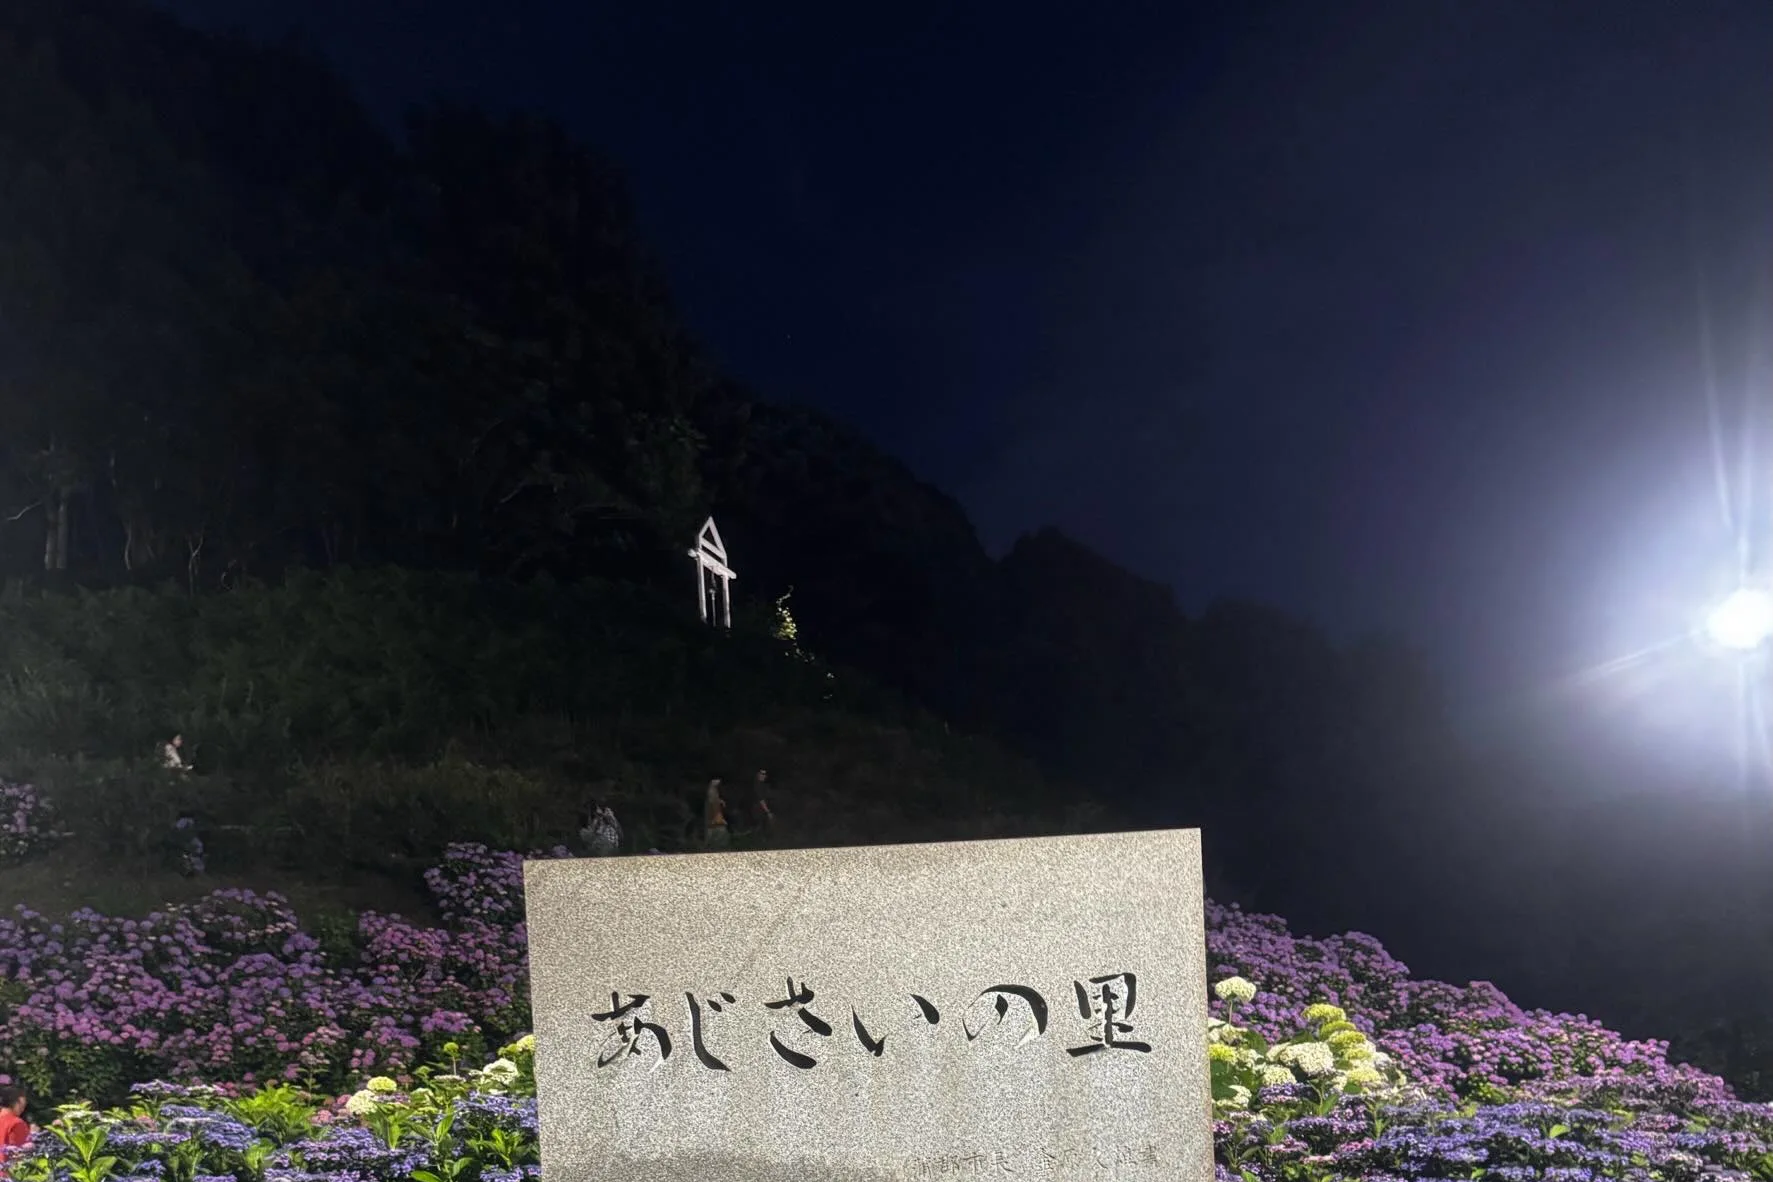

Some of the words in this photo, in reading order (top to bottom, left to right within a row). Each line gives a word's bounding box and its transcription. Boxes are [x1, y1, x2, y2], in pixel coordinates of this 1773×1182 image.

[591, 972, 1152, 1071] あじさいの里
